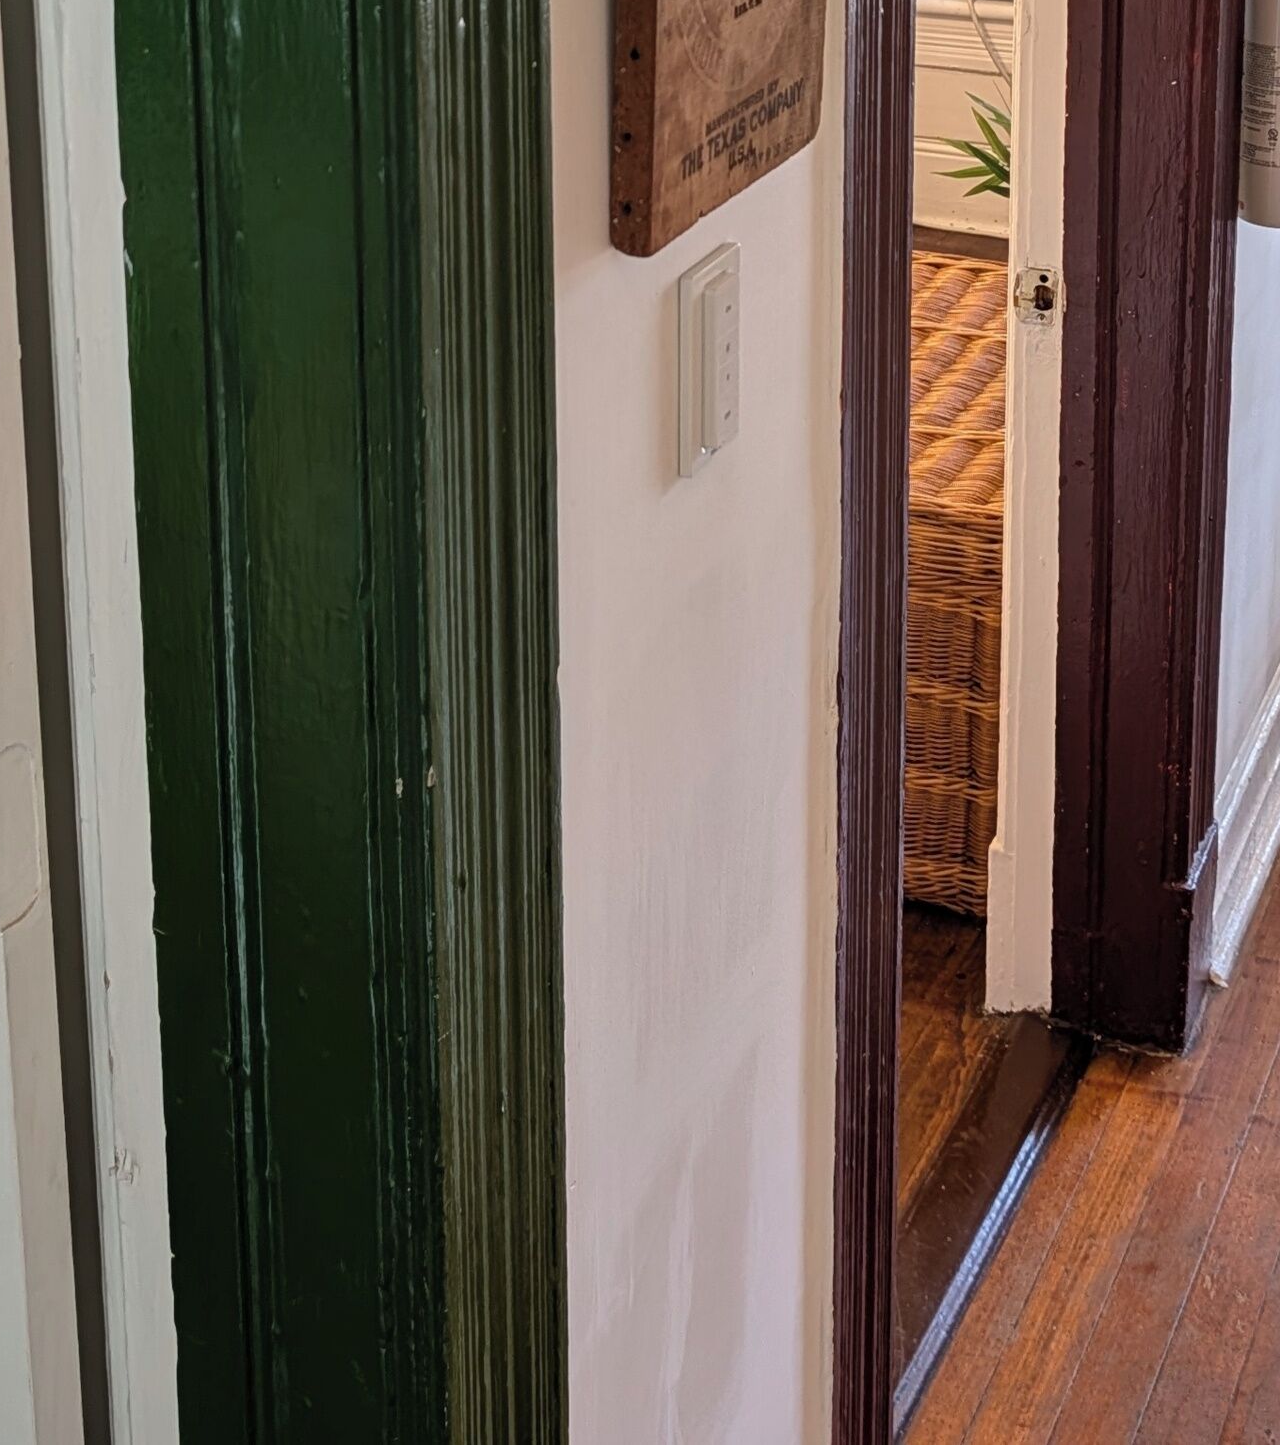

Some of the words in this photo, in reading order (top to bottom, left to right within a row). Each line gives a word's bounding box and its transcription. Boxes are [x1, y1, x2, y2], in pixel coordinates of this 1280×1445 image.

[681, 143, 704, 181] THE
[707, 116, 746, 162] TEXAS
[750, 77, 805, 133] COMPANY
